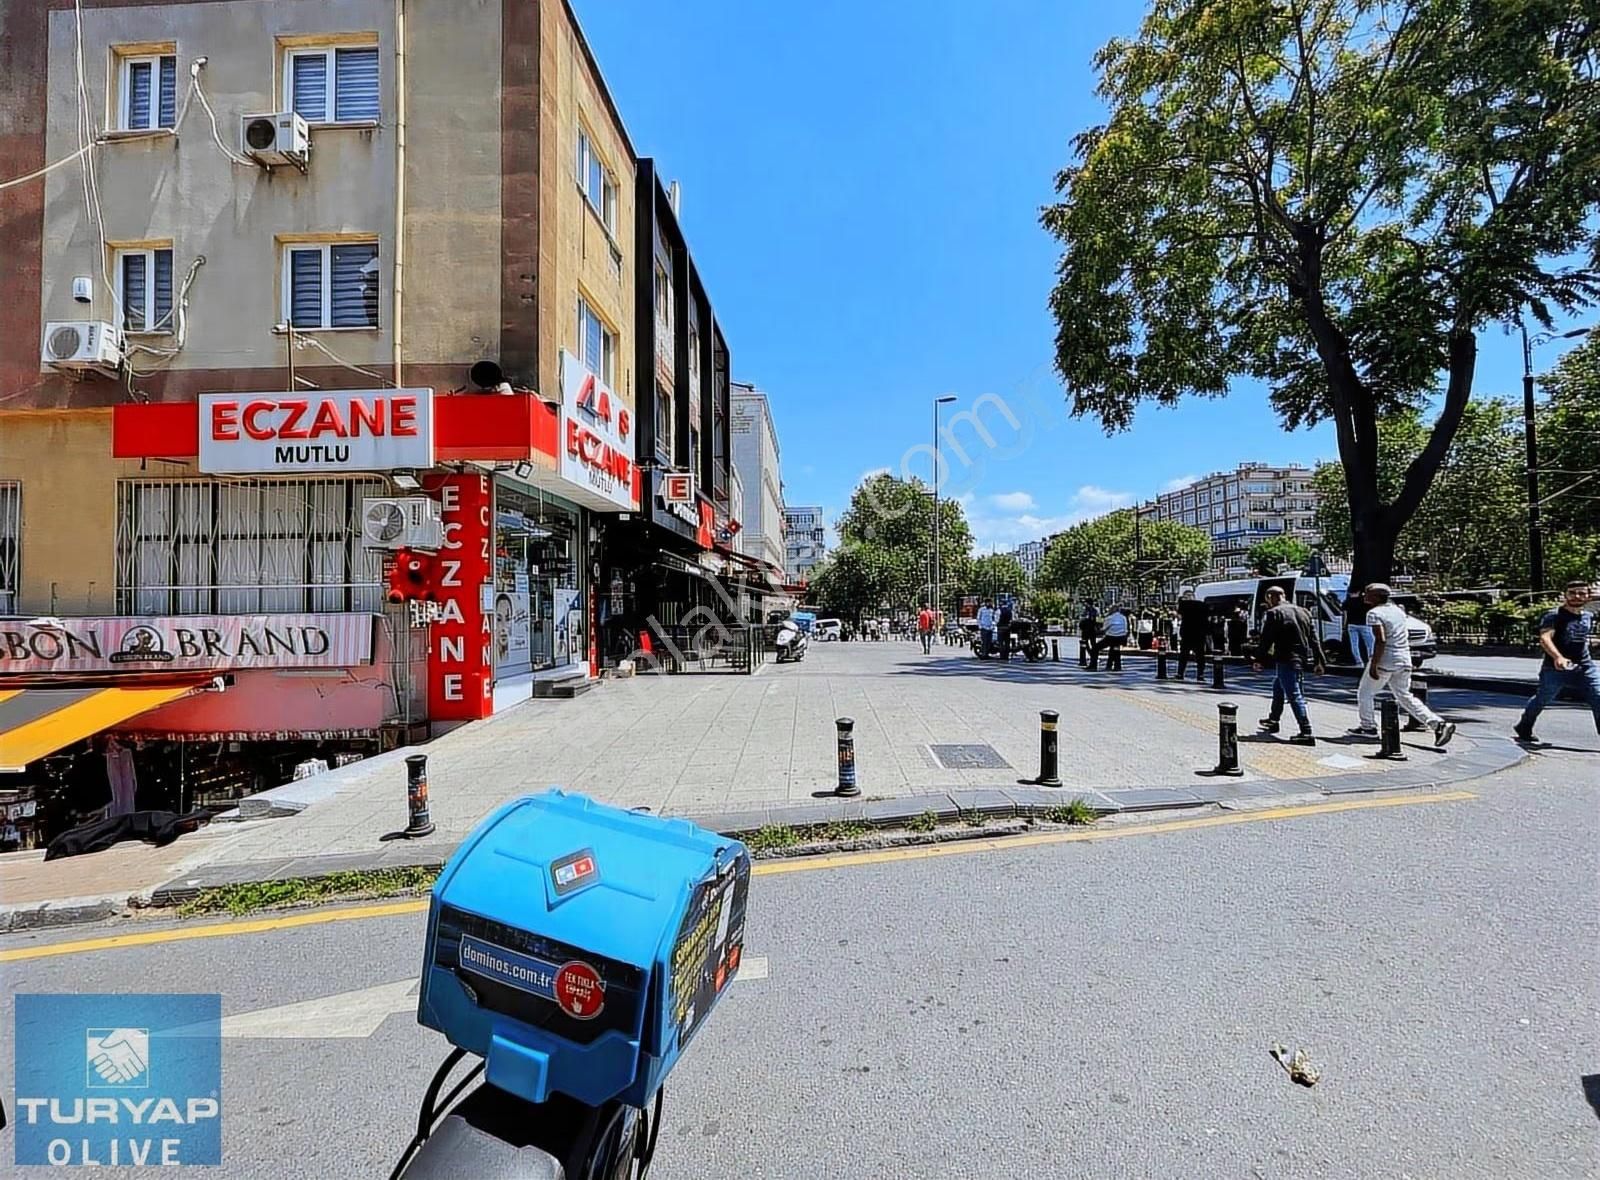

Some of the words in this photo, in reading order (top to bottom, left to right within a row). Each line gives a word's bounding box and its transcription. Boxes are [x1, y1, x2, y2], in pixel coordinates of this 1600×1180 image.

[211, 396, 418, 440] ECZANE
[275, 445, 350, 463] MUTLU
[566, 417, 631, 486] ECZANE
[671, 479, 687, 498] E
[441, 486, 465, 701] ECZANE
[0, 631, 104, 660] BON
[174, 626, 330, 658] BRAND
[463, 945, 552, 988] dominos.com.tr
